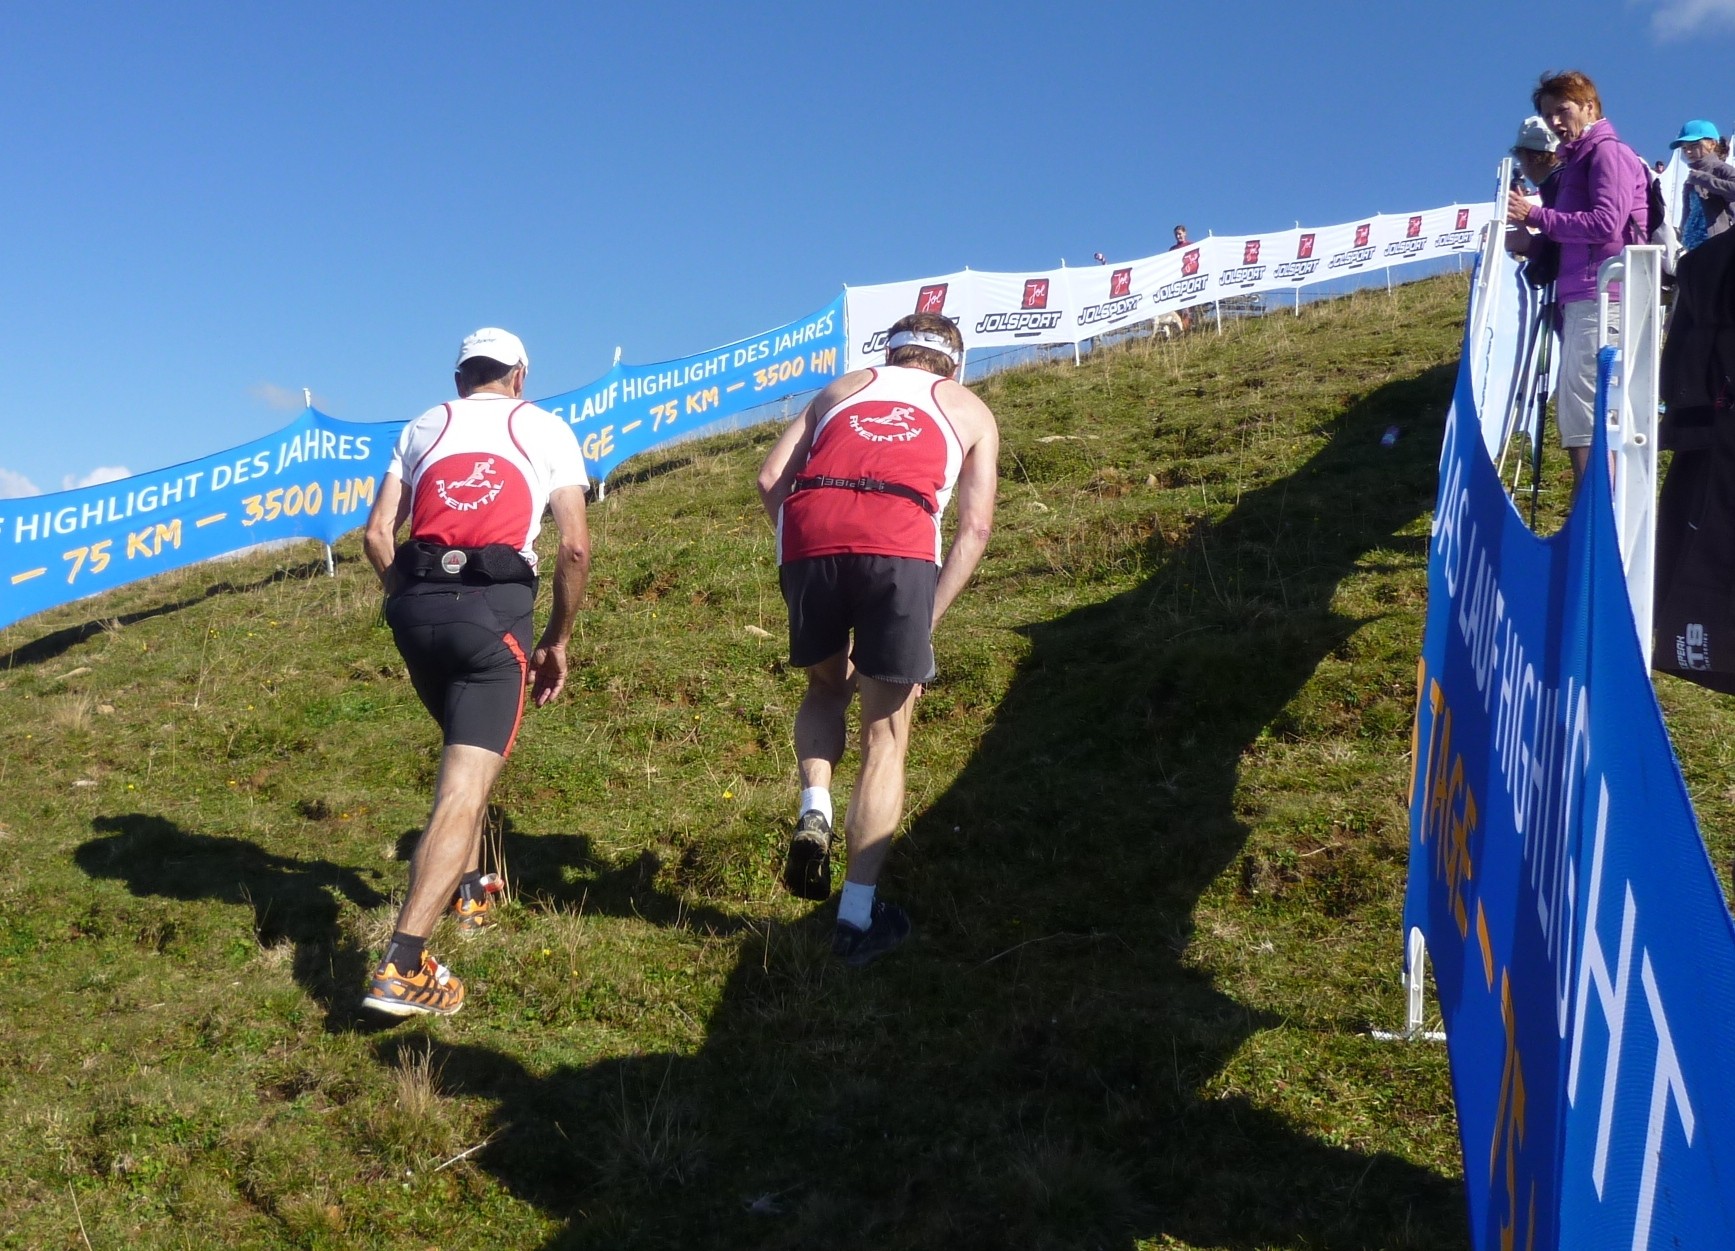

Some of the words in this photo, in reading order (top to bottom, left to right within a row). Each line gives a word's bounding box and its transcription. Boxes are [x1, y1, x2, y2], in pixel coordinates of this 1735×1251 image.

[1328, 246, 1376, 269] JOLSPORT
[1384, 237, 1427, 257] JOLSPORT
[1219, 266, 1266, 287] JOLSPORT
[1273, 259, 1320, 279] JOLSPORT
[922, 289, 943, 313] Jol
[1027, 284, 1046, 306] Jol
[1153, 274, 1209, 303] JOLSPORT
[975, 311, 1062, 333] JOLSPORT
[1077, 295, 1143, 326] JOLSPORT
[569, 382, 618, 425] LAUF
[622, 353, 731, 403] HIGHLIGHT
[733, 340, 770, 369] DES
[773, 309, 835, 356] JAHRES
[650, 398, 678, 433] 75
[686, 386, 719, 415] KM
[753, 356, 805, 392] 3500
[810, 346, 838, 376] HM
[849, 414, 923, 442] RHEINTAL
[15, 472, 204, 544] HIGHLIGHT
[211, 450, 271, 491] DES
[275, 429, 371, 475] JAHRES
[62, 539, 113, 584] 75
[127, 518, 182, 561] KM
[242, 481, 322, 527] 3500
[331, 476, 375, 515] HM
[1458, 520, 1506, 714] LAUF
